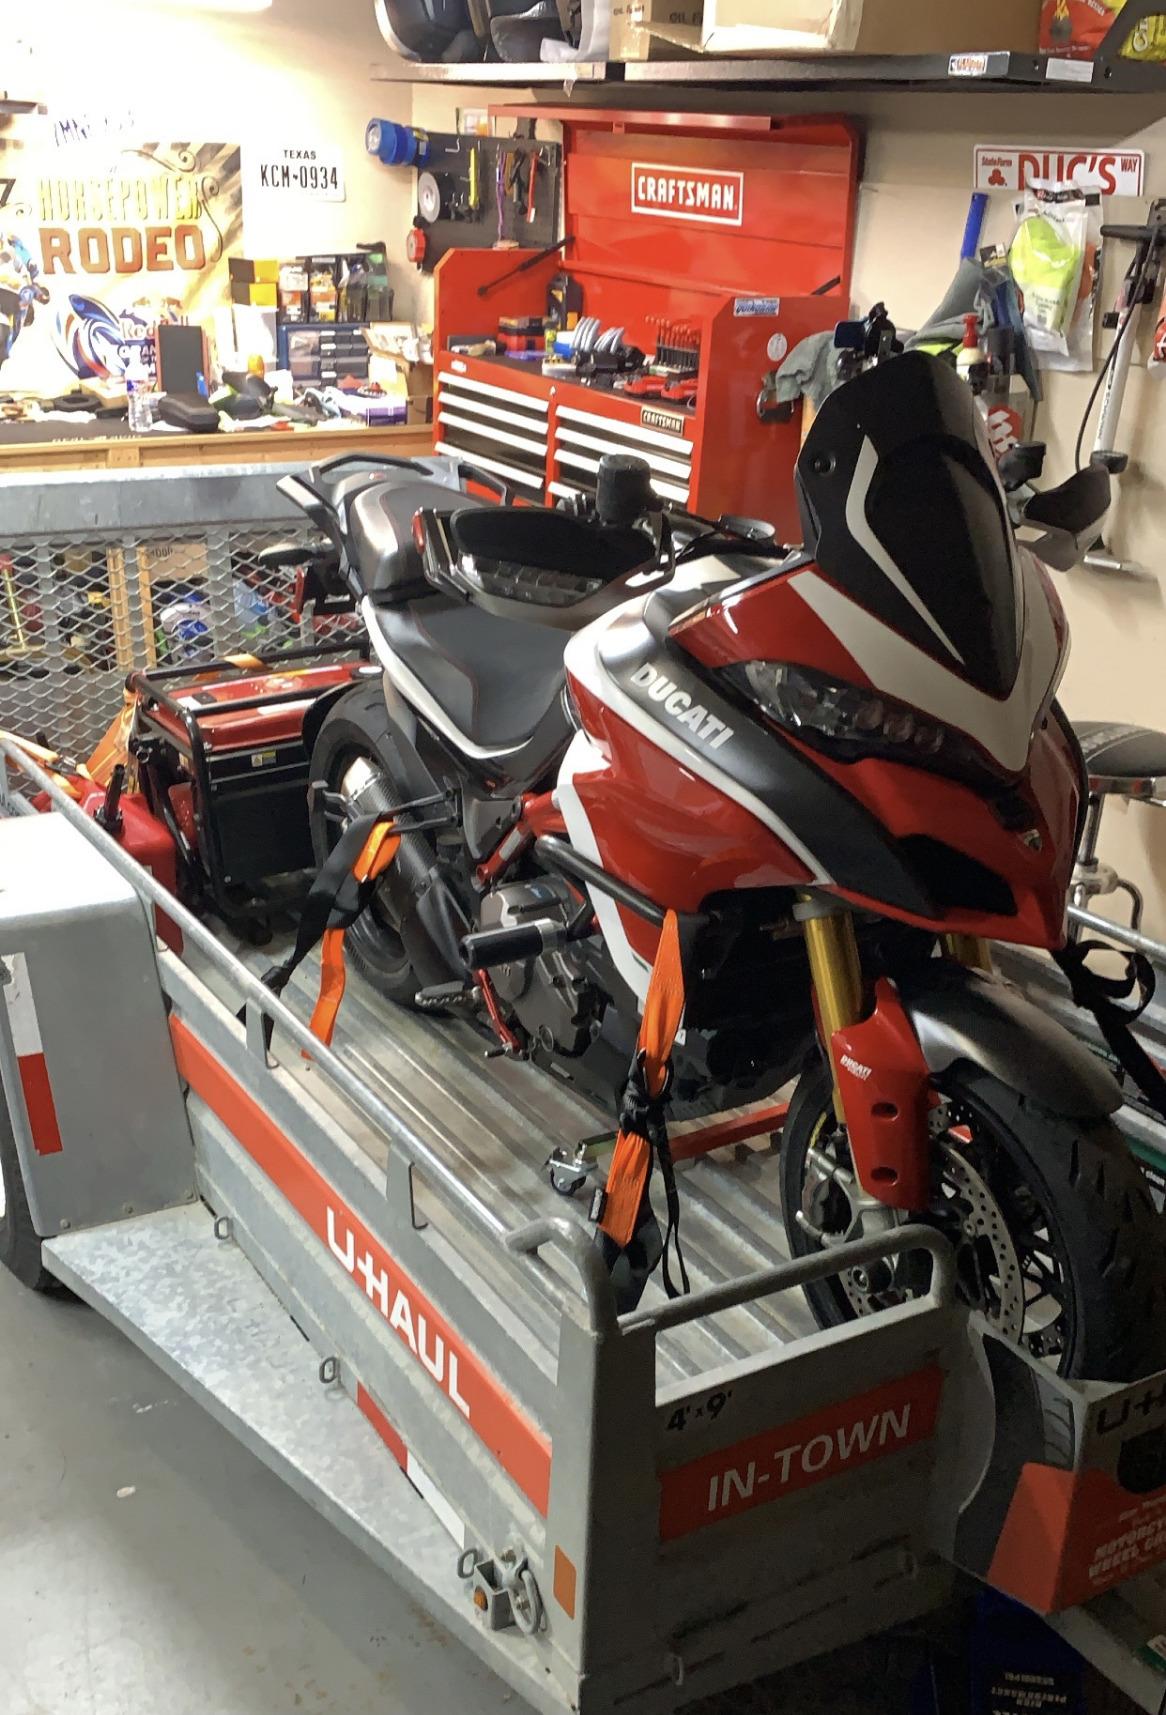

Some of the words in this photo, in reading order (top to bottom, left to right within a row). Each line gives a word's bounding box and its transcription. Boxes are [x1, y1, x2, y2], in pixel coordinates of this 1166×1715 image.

[284, 149, 317, 160] TEXAS
[1018, 153, 1117, 196] DUC'S
[1120, 158, 1138, 173] WAY
[638, 175, 734, 211] CRAFTSMAN
[38, 224, 207, 275] RODEO
[630, 662, 735, 750] DUCATI
[840, 1054, 872, 1081] DUCATI
[707, 1403, 912, 1512] IN-TOWN
